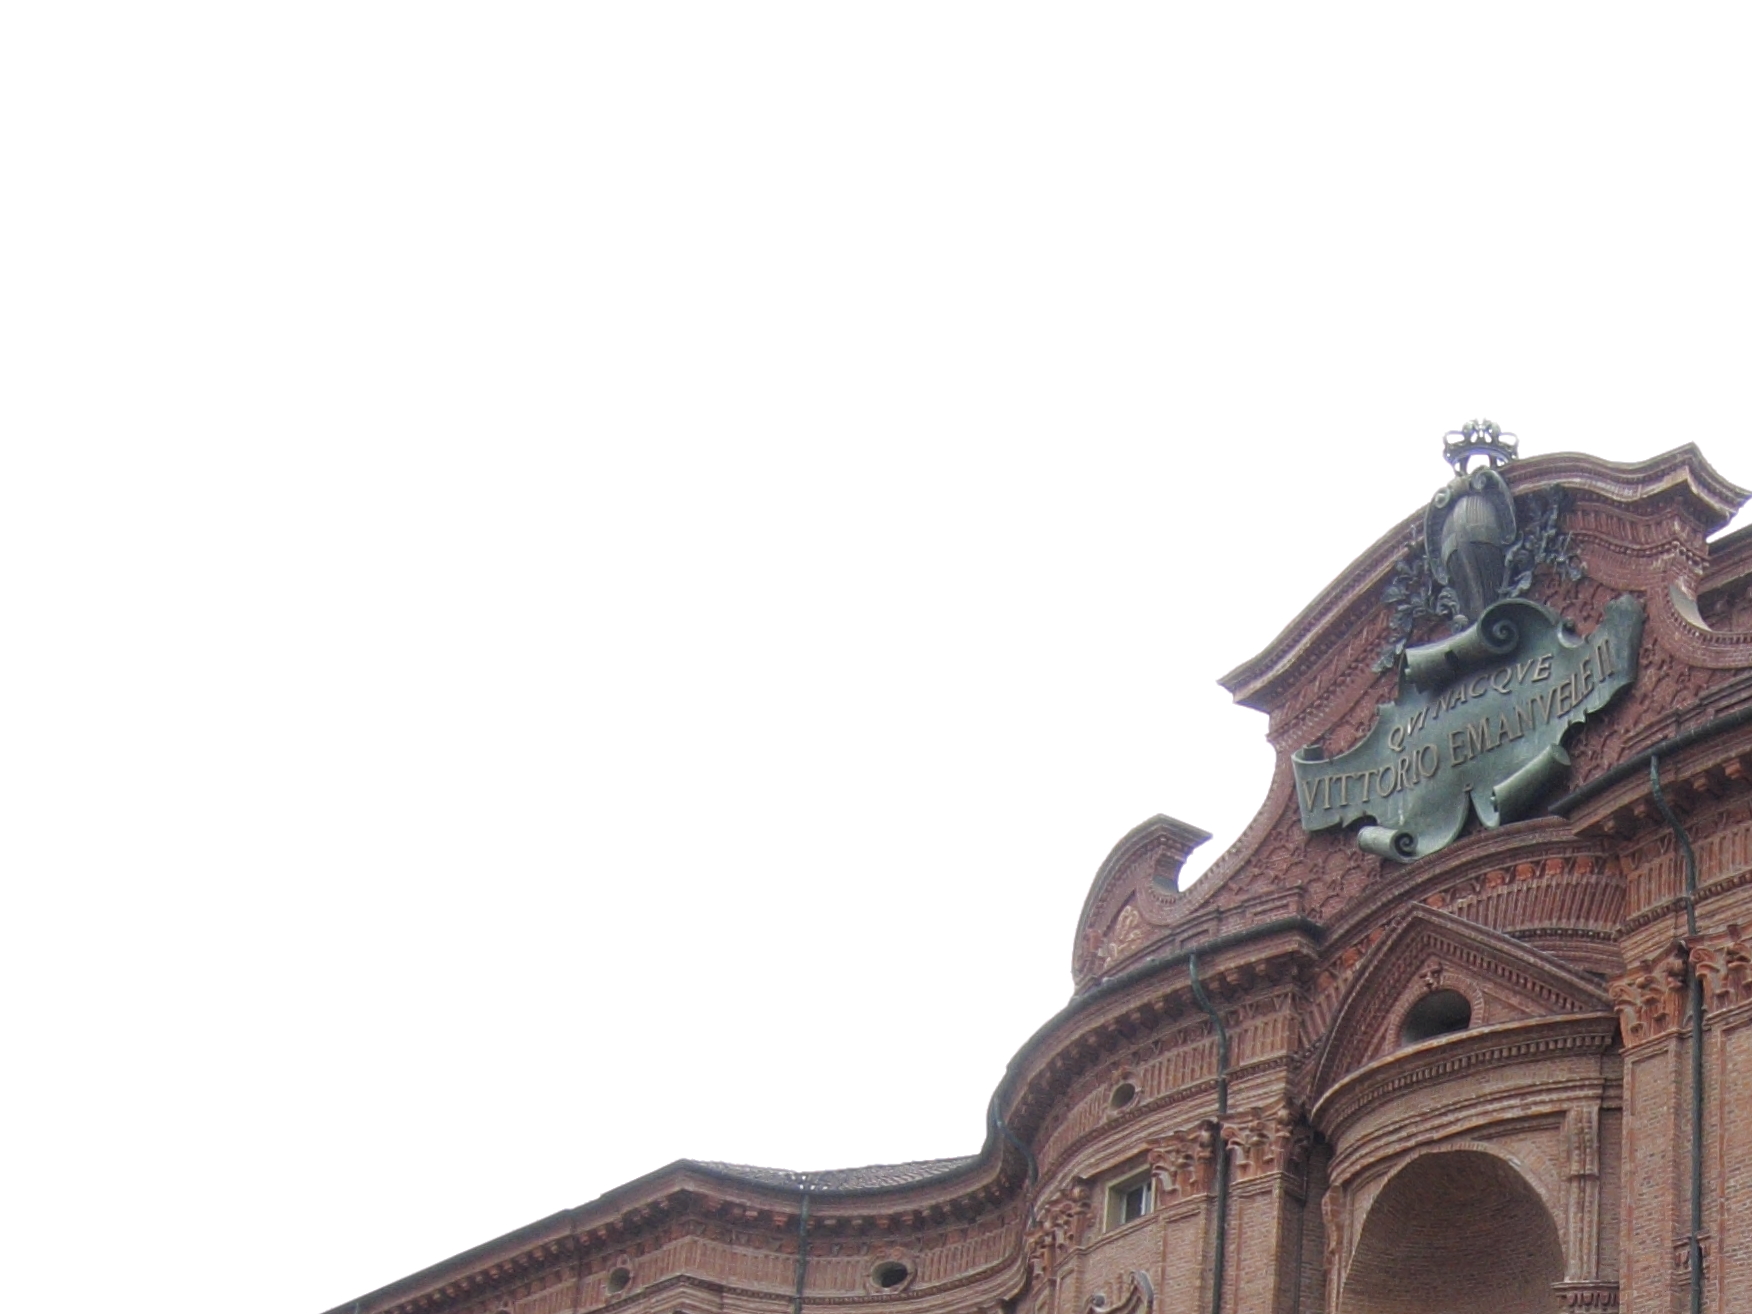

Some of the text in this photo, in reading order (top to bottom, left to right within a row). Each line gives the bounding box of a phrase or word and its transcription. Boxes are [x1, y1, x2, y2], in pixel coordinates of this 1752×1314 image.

[1301, 638, 1616, 812] VITTORIO EMANVELE II
[1388, 654, 1554, 752] QVI NACQVE
